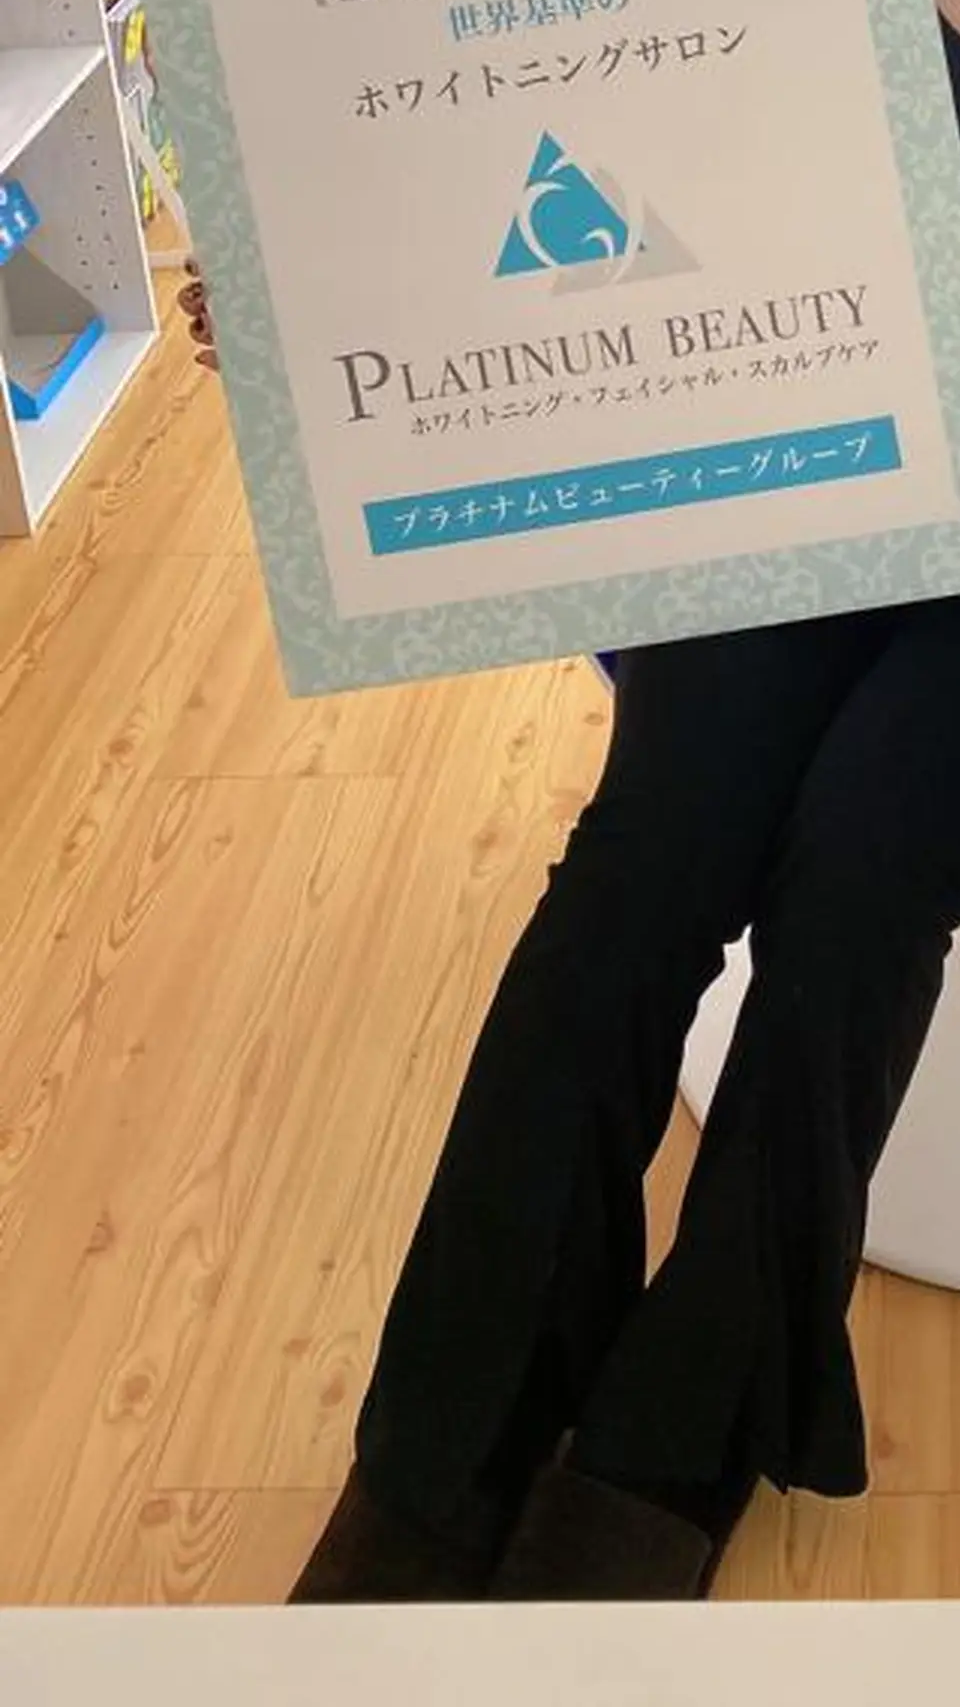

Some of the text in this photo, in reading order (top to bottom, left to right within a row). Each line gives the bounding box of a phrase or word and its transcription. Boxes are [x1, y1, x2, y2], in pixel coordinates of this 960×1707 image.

[355, 24, 747, 119] ホワイトニングサロン
[334, 285, 868, 422] PLATINUM BEAUTY
[395, 435, 872, 540] プラチナムビューティーグループ
